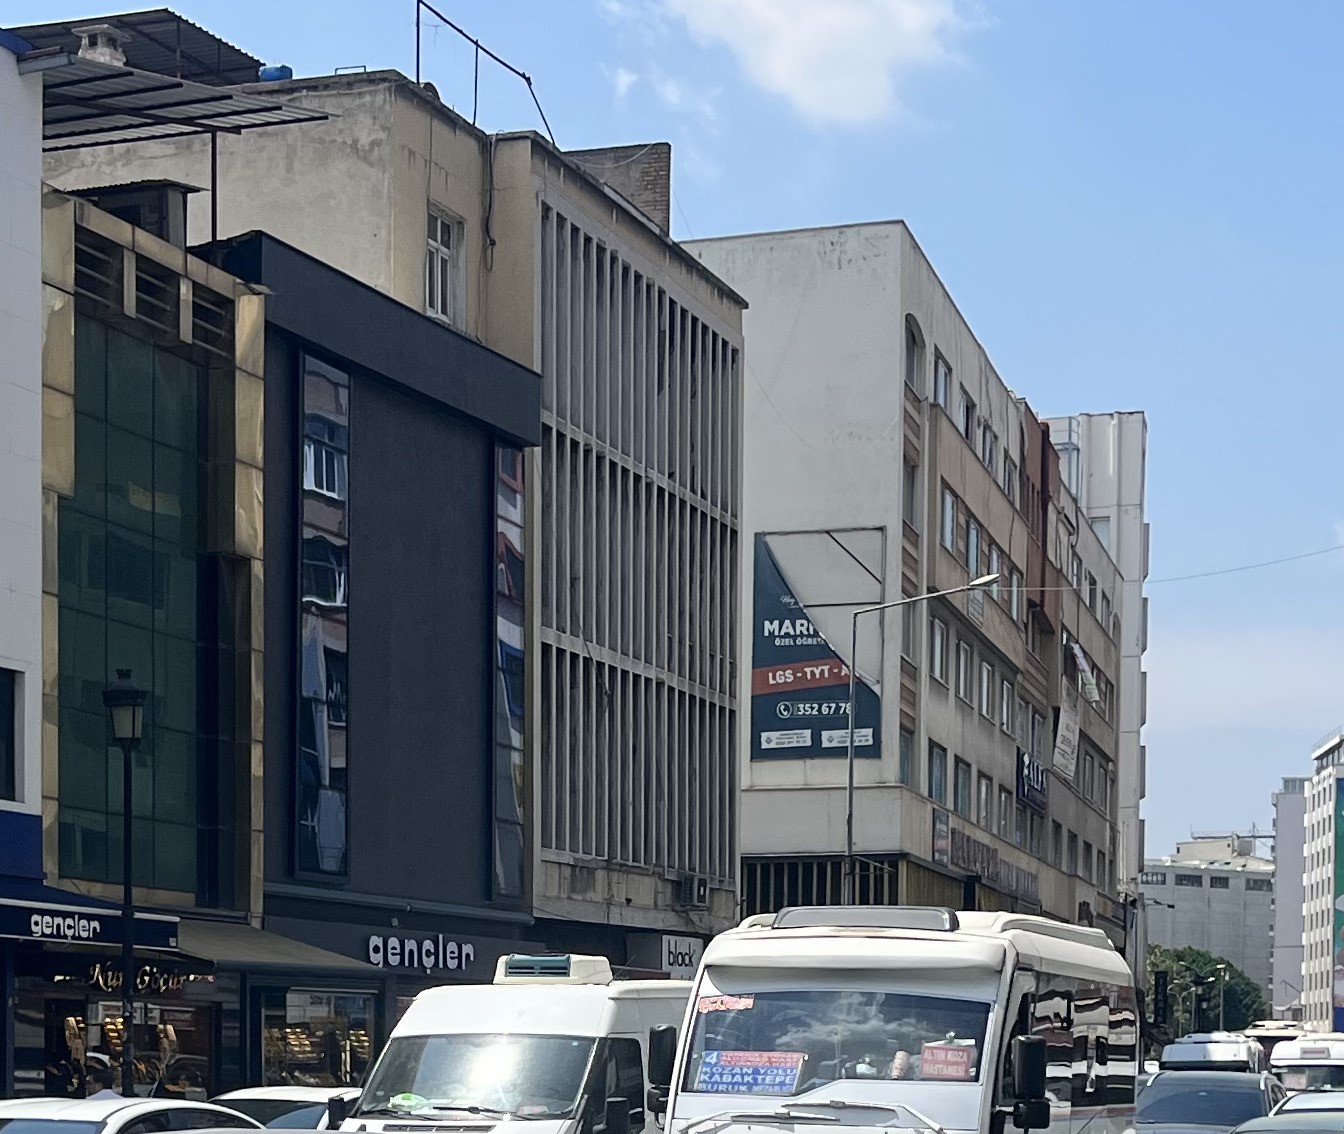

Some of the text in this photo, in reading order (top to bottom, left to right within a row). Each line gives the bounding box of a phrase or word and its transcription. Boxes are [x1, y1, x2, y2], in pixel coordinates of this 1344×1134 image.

[768, 669, 794, 685] LGS
[804, 665, 831, 680] TYT
[797, 703, 819, 715] 352
[821, 703, 836, 715] 67
[30, 914, 101, 942] gençler
[368, 933, 474, 975] gençler
[668, 939, 696, 967] block
[704, 1051, 719, 1064] 4
[701, 1066, 797, 1076] KOZAN YOLU
